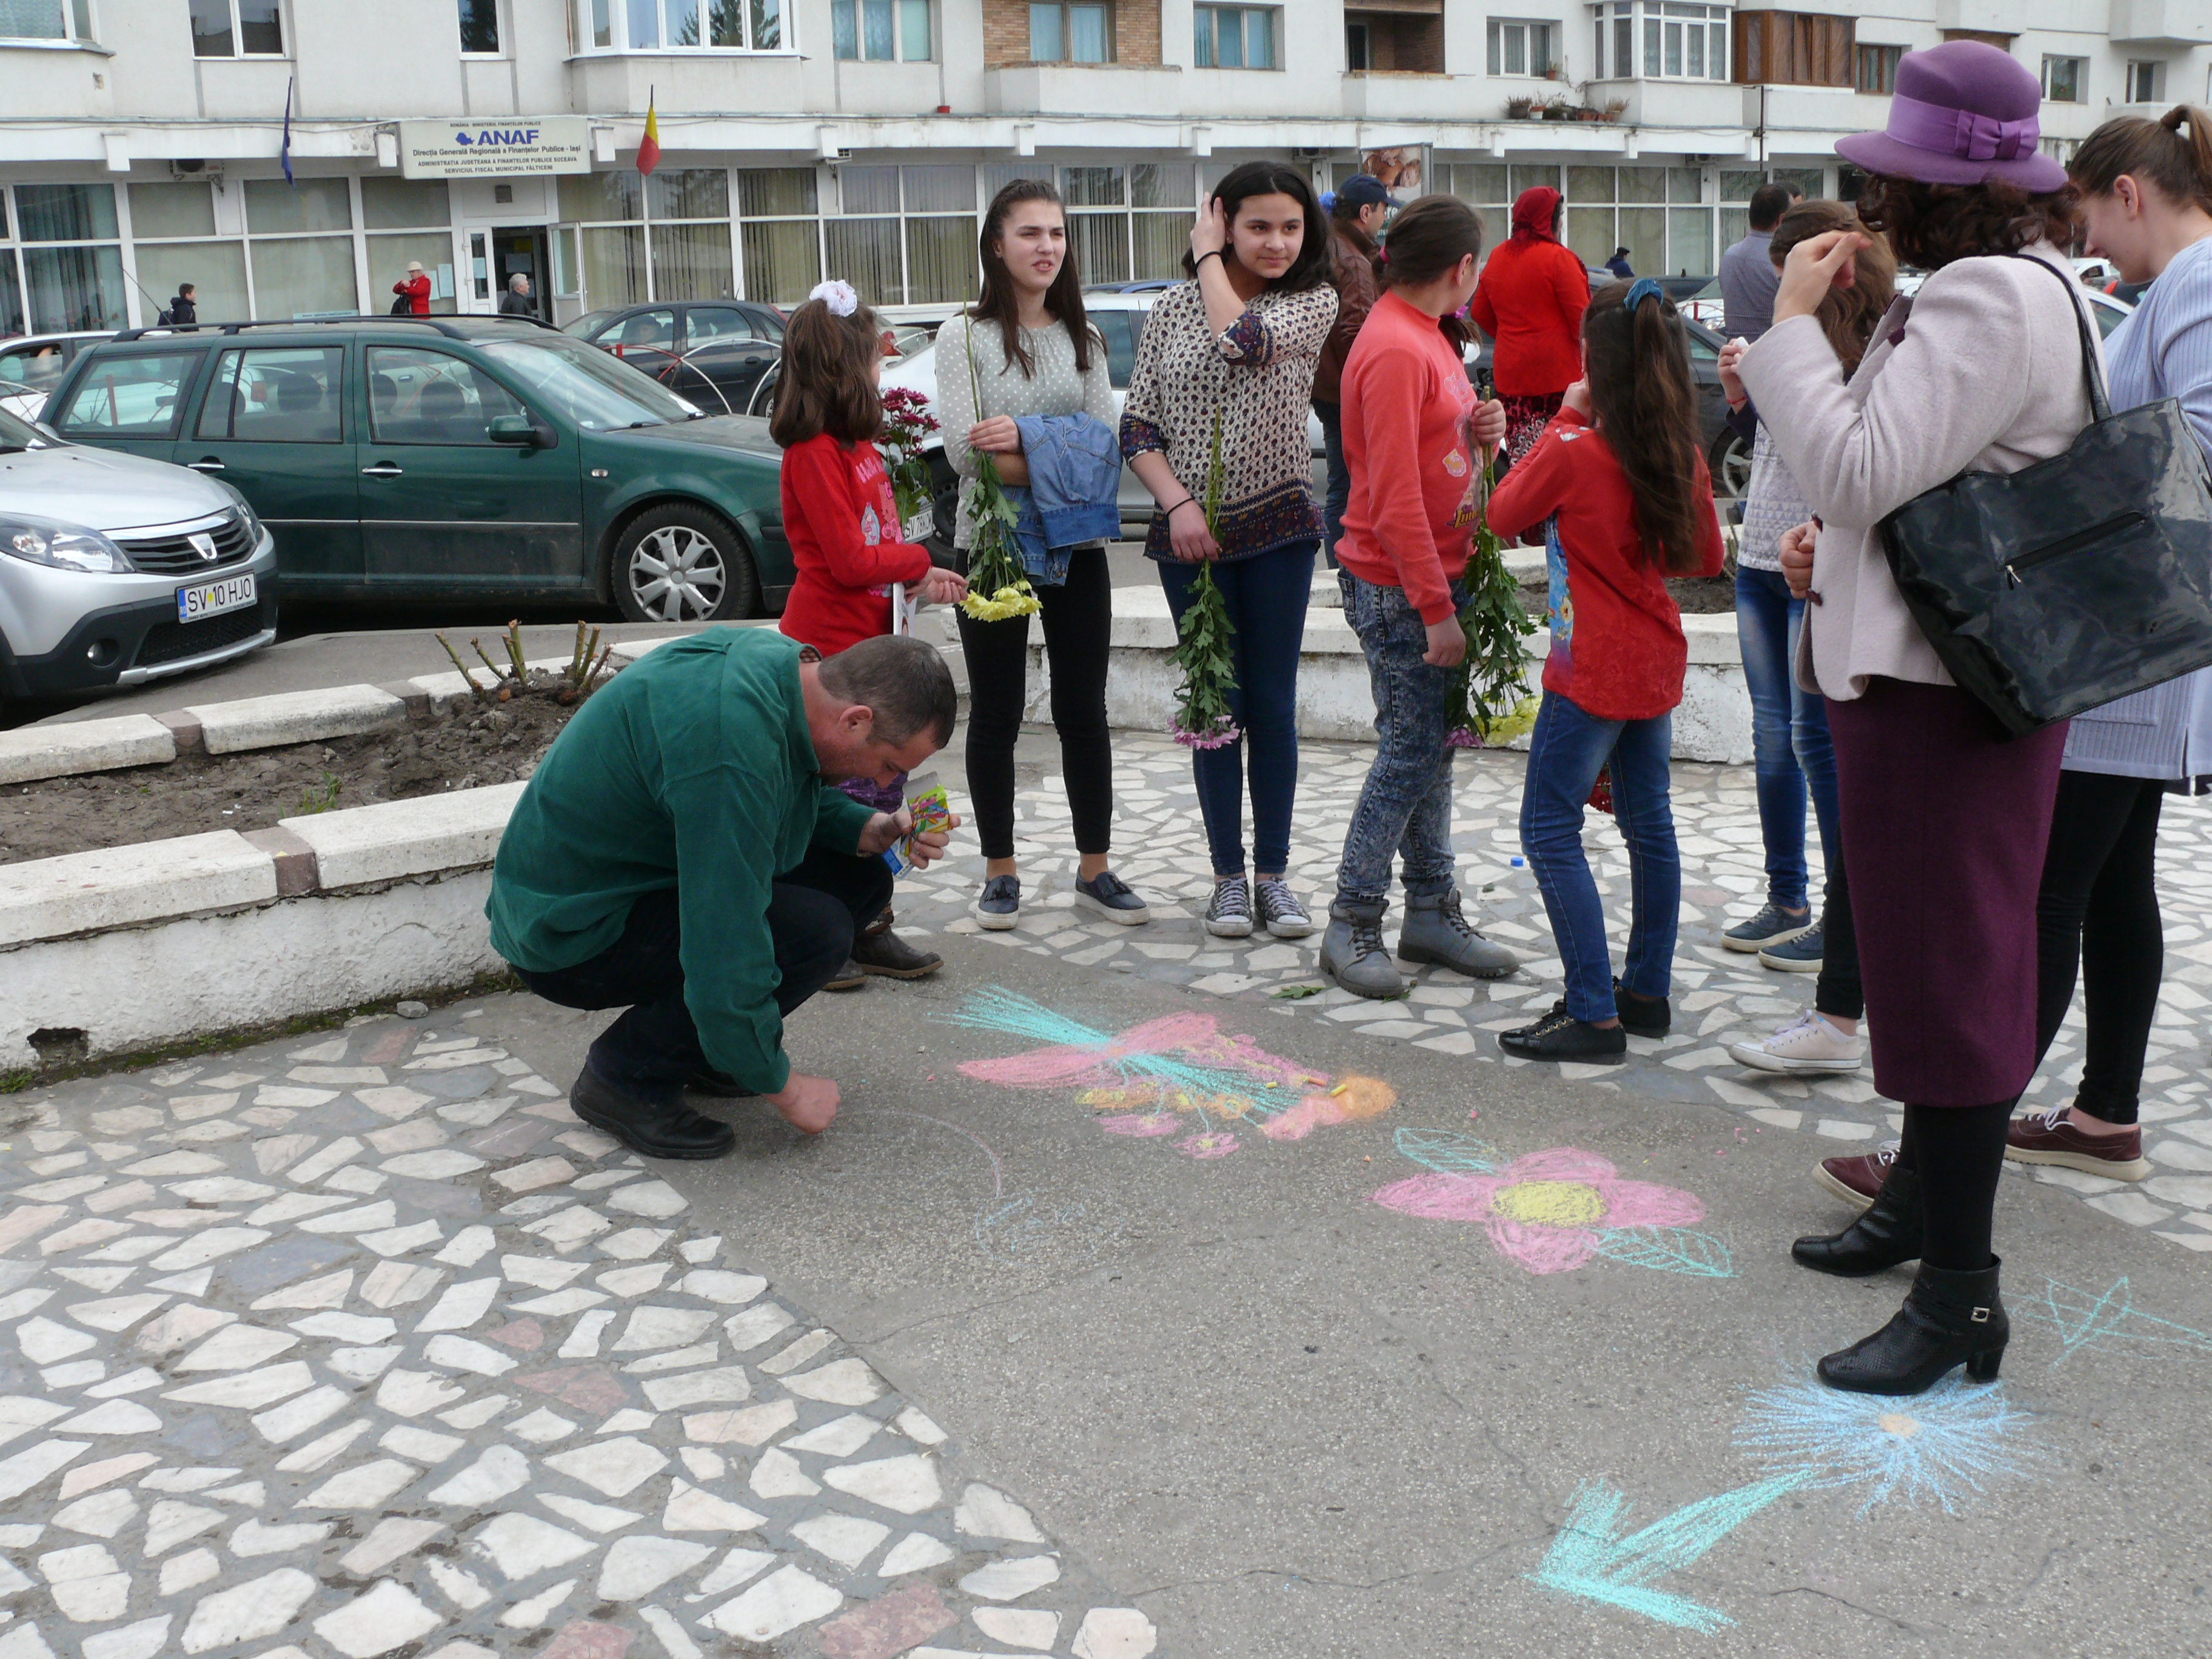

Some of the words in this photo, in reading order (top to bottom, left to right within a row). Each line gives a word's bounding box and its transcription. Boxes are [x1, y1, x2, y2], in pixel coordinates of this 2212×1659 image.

[477, 130, 539, 146] ANAF
[469, 147, 501, 156] Regională
[187, 588, 207, 612] SV
[213, 585, 225, 607] 10
[228, 578, 251, 603] HJO
